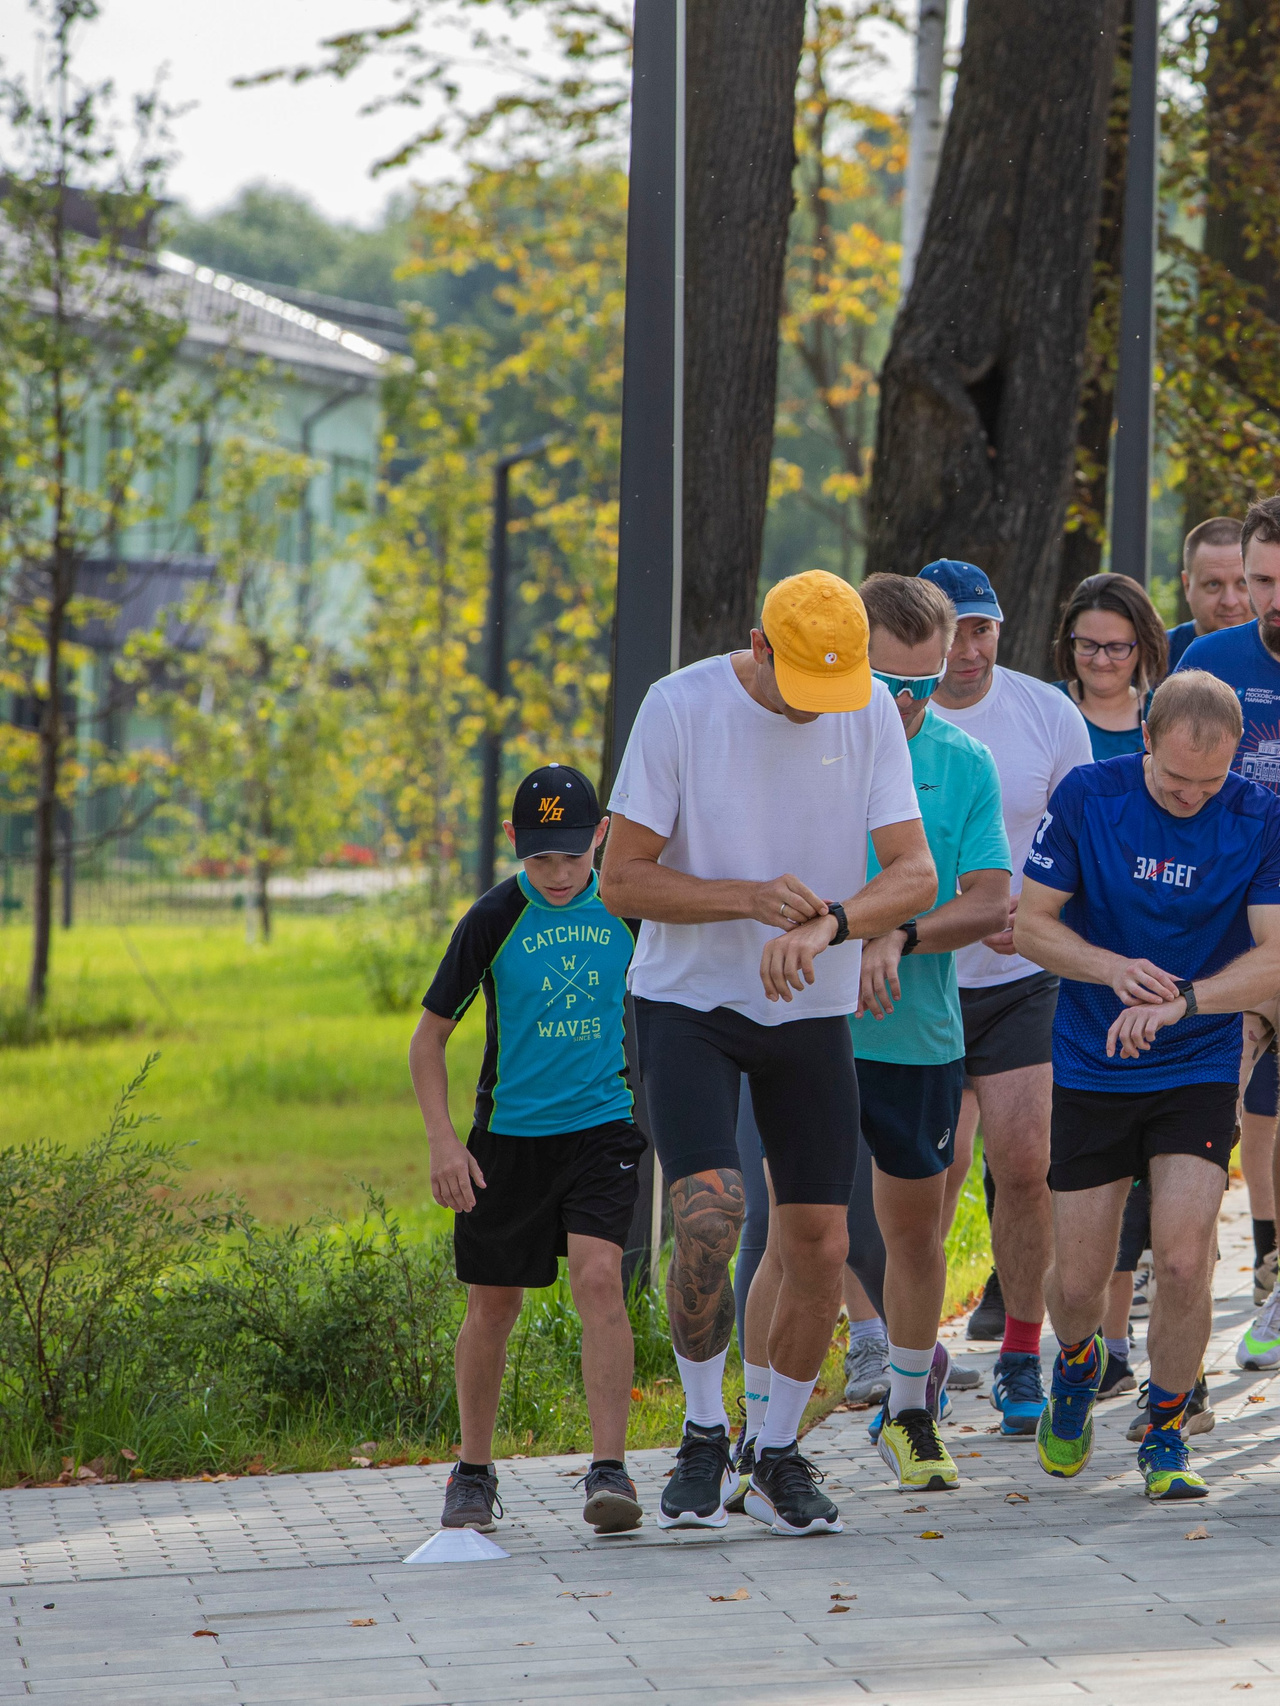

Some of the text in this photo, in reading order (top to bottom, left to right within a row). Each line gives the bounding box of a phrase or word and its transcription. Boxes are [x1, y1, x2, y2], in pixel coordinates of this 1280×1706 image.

[1244, 697, 1273, 705] МАРАФОН
[522, 925, 611, 954] CATCHING
[561, 954, 577, 971] W
[541, 976, 553, 992] A
[565, 994, 577, 1009] P
[537, 1016, 601, 1037] WAVES
[573, 1034, 591, 1043] SINCE
